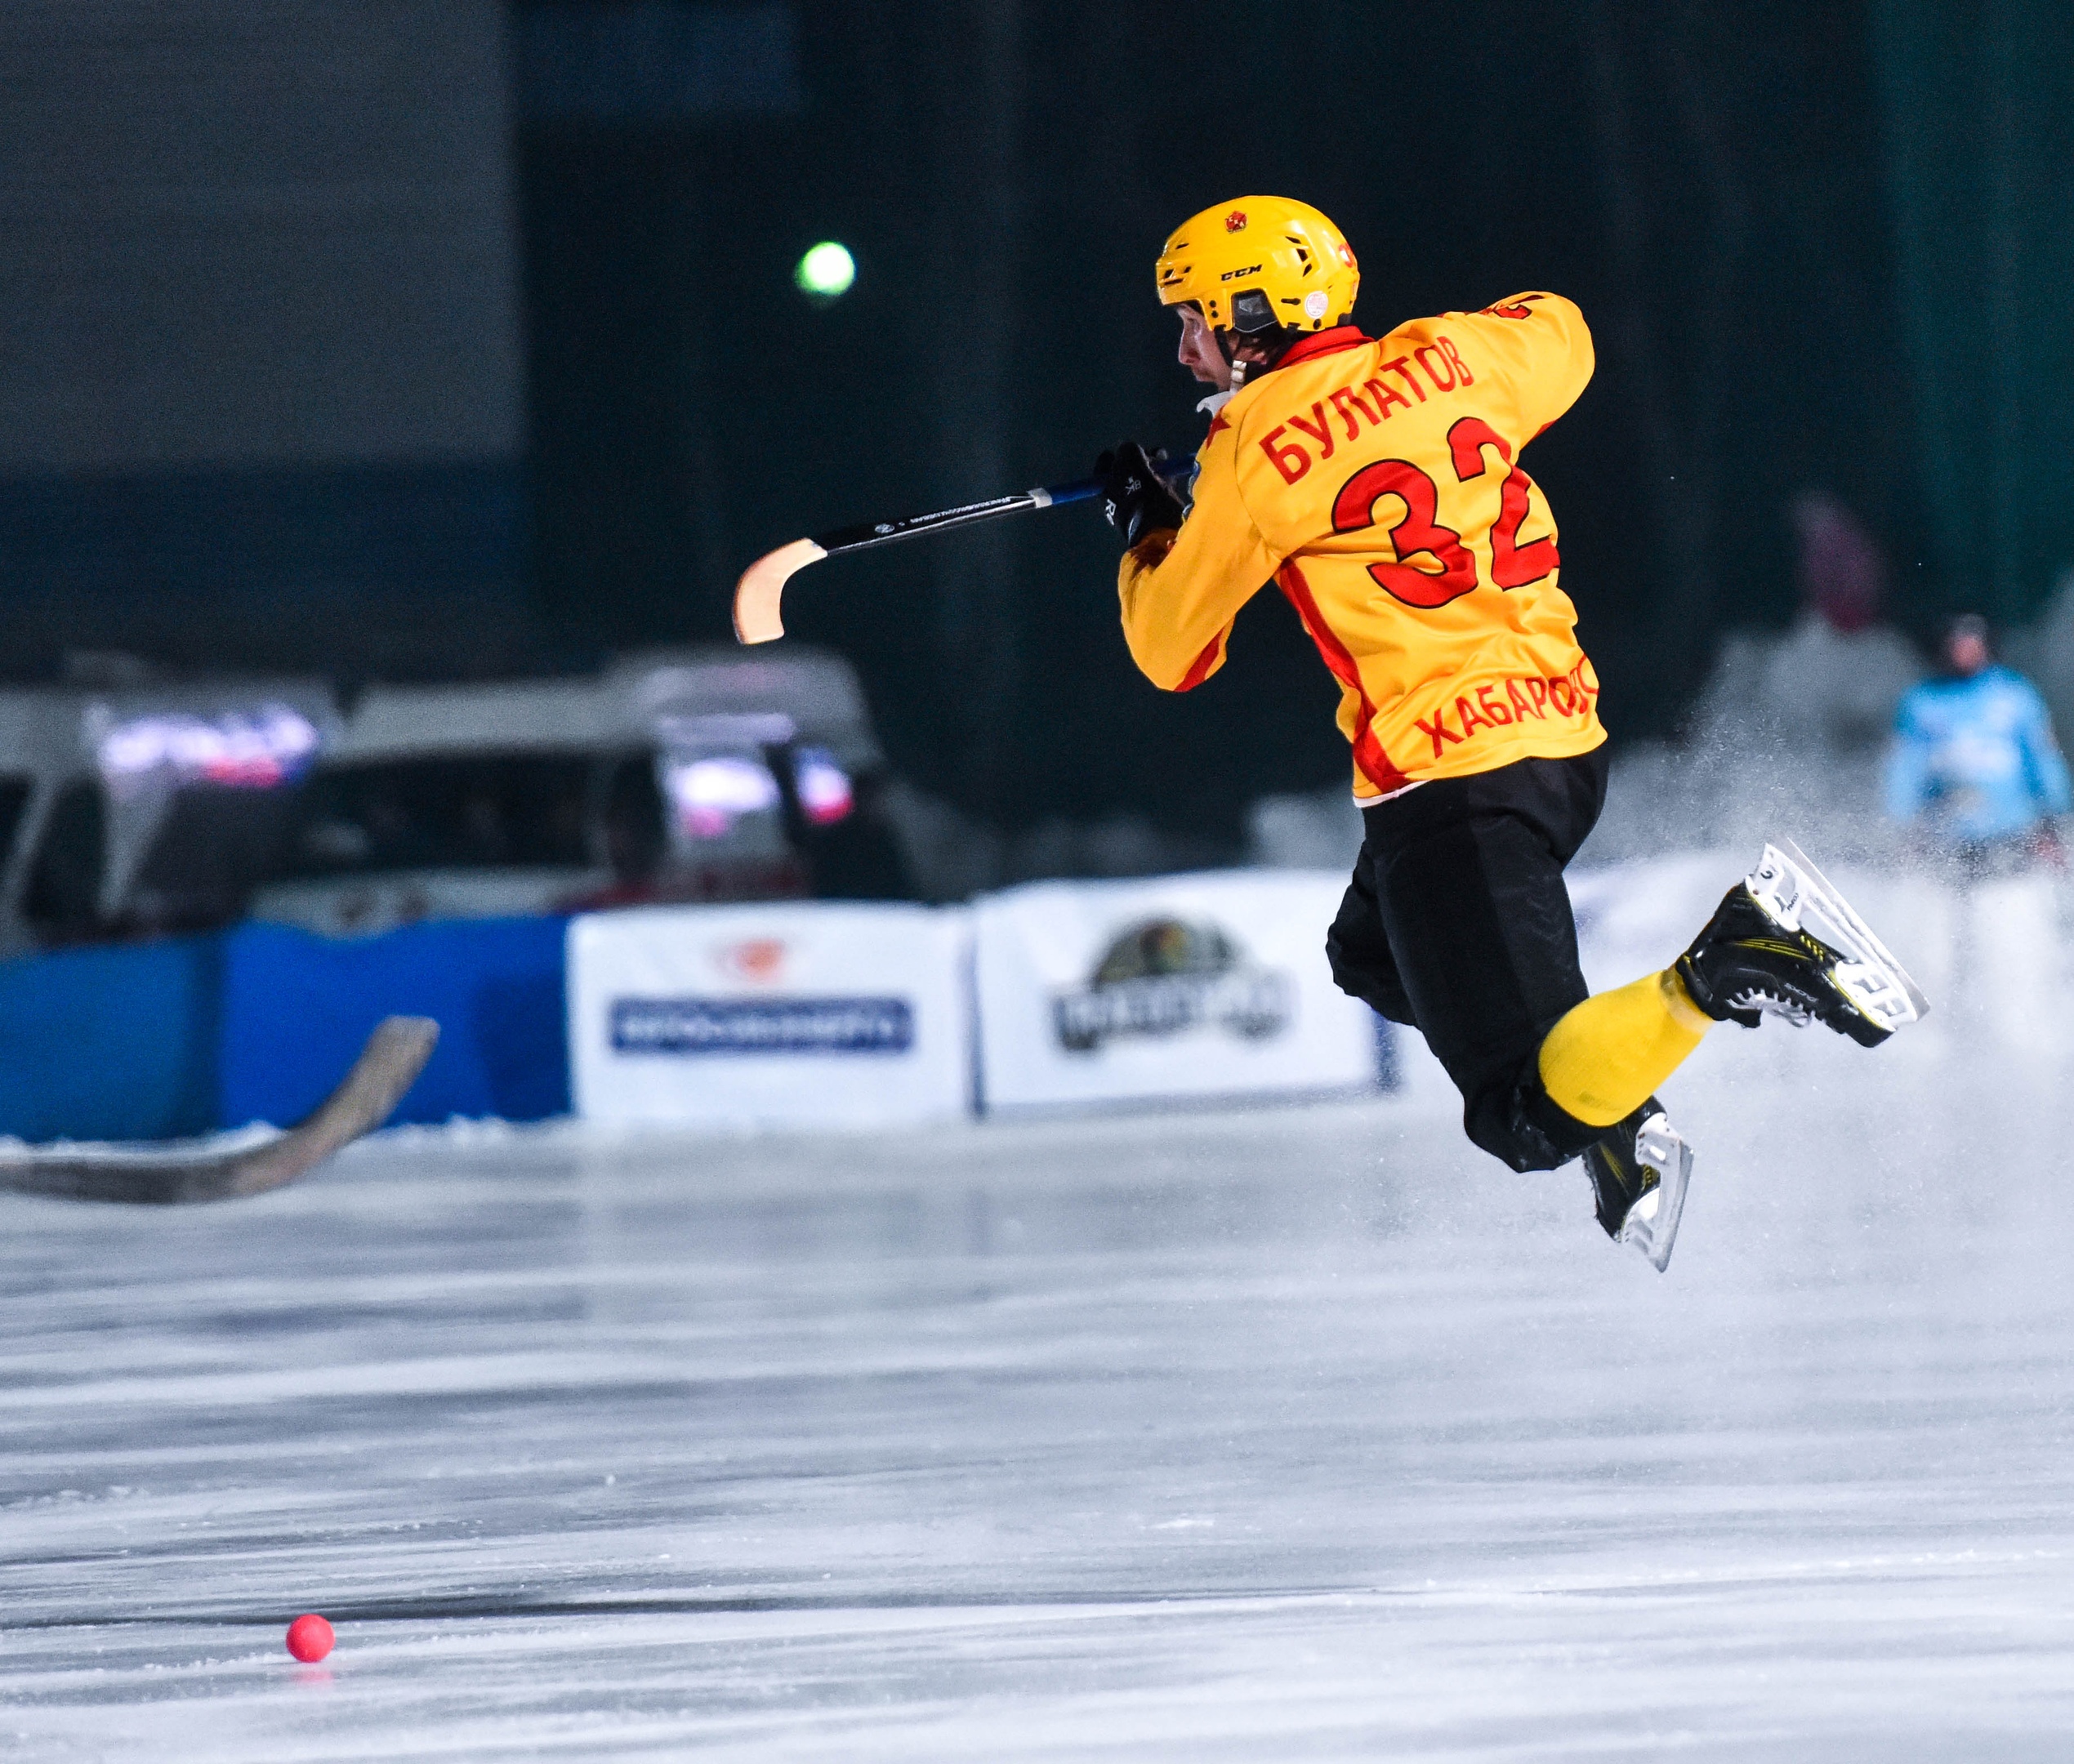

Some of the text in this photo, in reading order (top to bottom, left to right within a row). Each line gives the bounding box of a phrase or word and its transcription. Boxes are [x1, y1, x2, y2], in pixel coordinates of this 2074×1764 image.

[1220, 264, 1263, 282] CCM
[1259, 336, 1474, 486] БУЛАТОВ
[1331, 416, 1560, 609] 32
